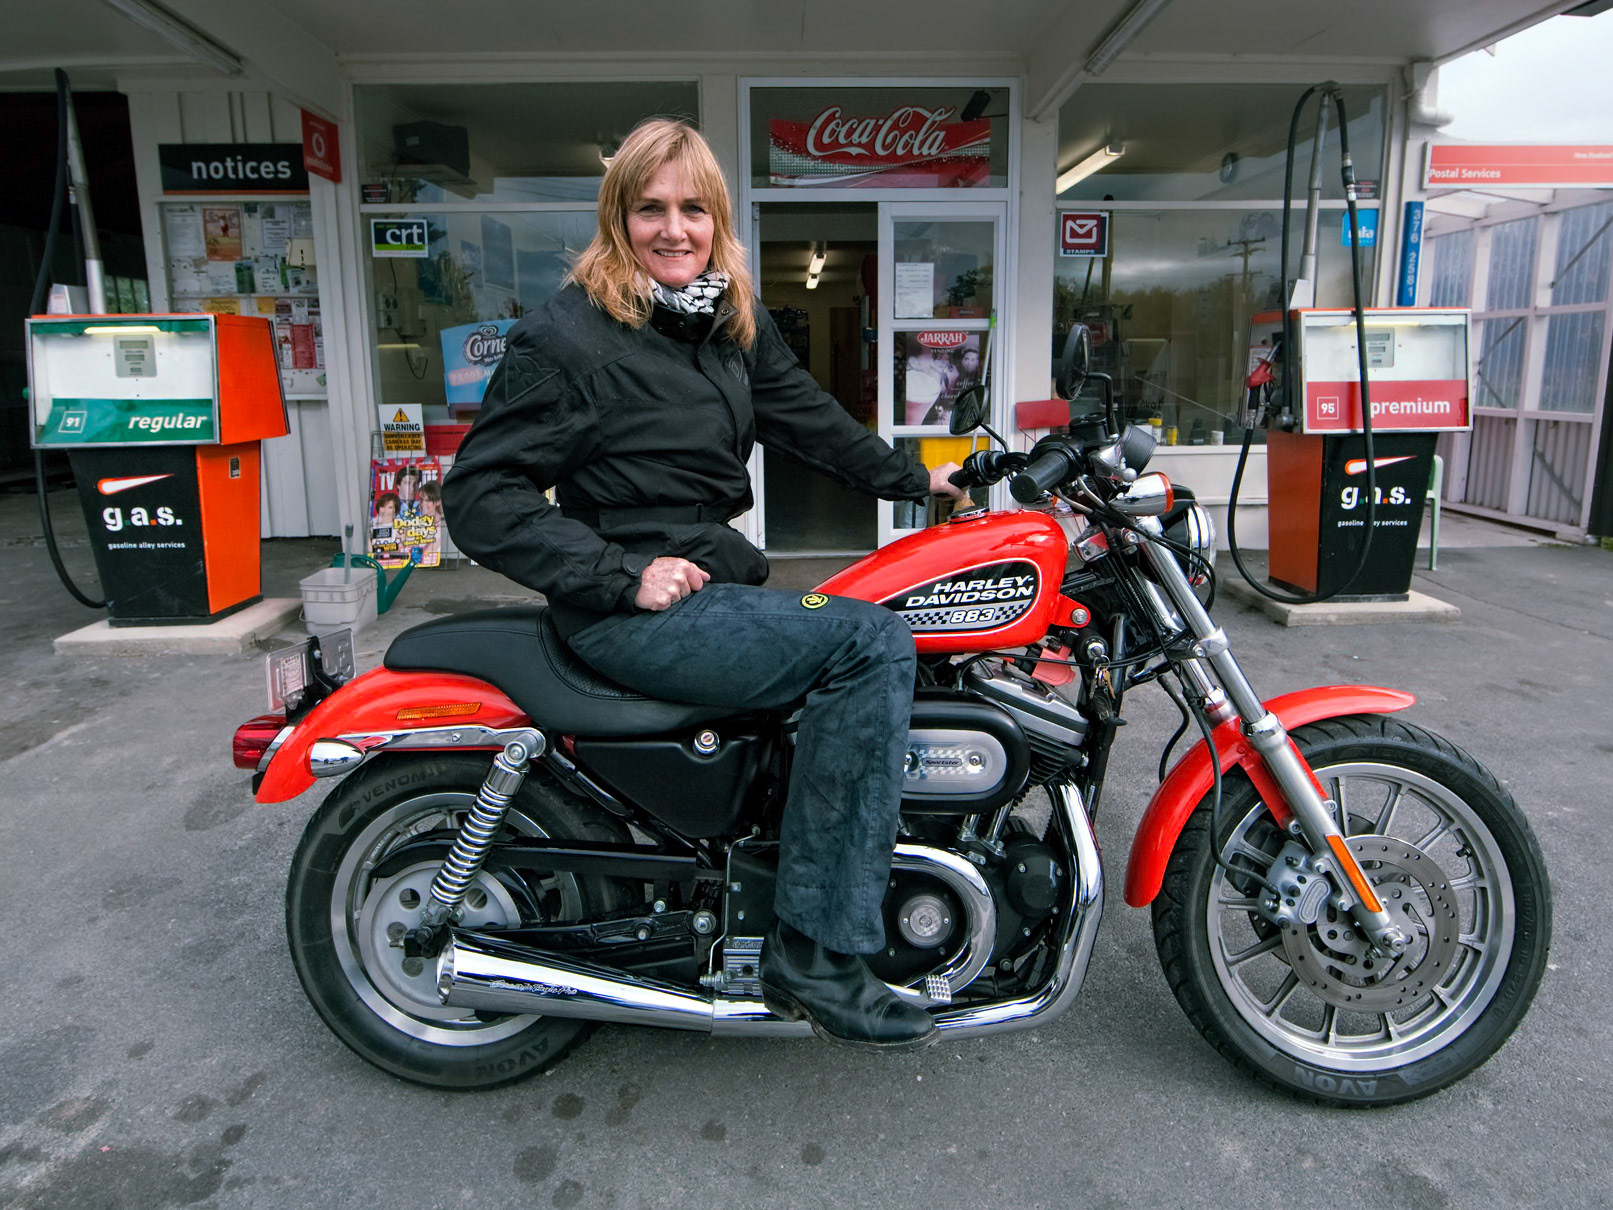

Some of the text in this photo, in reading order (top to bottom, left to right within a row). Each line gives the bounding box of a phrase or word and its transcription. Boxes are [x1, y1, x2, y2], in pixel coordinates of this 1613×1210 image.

[807, 106, 955, 156] Coca-Cola
[191, 155, 291, 179] notices
[1429, 168, 1501, 179] Postal Services
[386, 224, 422, 245] crt
[921, 332, 962, 345] JARRAH
[1321, 403, 1335, 414] 95
[1370, 398, 1451, 419] premium
[66, 417, 80, 427] 91
[128, 413, 208, 433] regular
[384, 423, 421, 432] WARNING
[379, 472, 396, 491] TV
[103, 506, 183, 532] g.a.s.
[1337, 520, 1364, 528] gasoline
[108, 541, 186, 550] gasoline alley services
[933, 575, 1034, 594] HARLEY-
[905, 586, 1035, 607] DAVIDSON
[951, 608, 996, 624] 883
[1293, 1065, 1378, 1097] AVON
